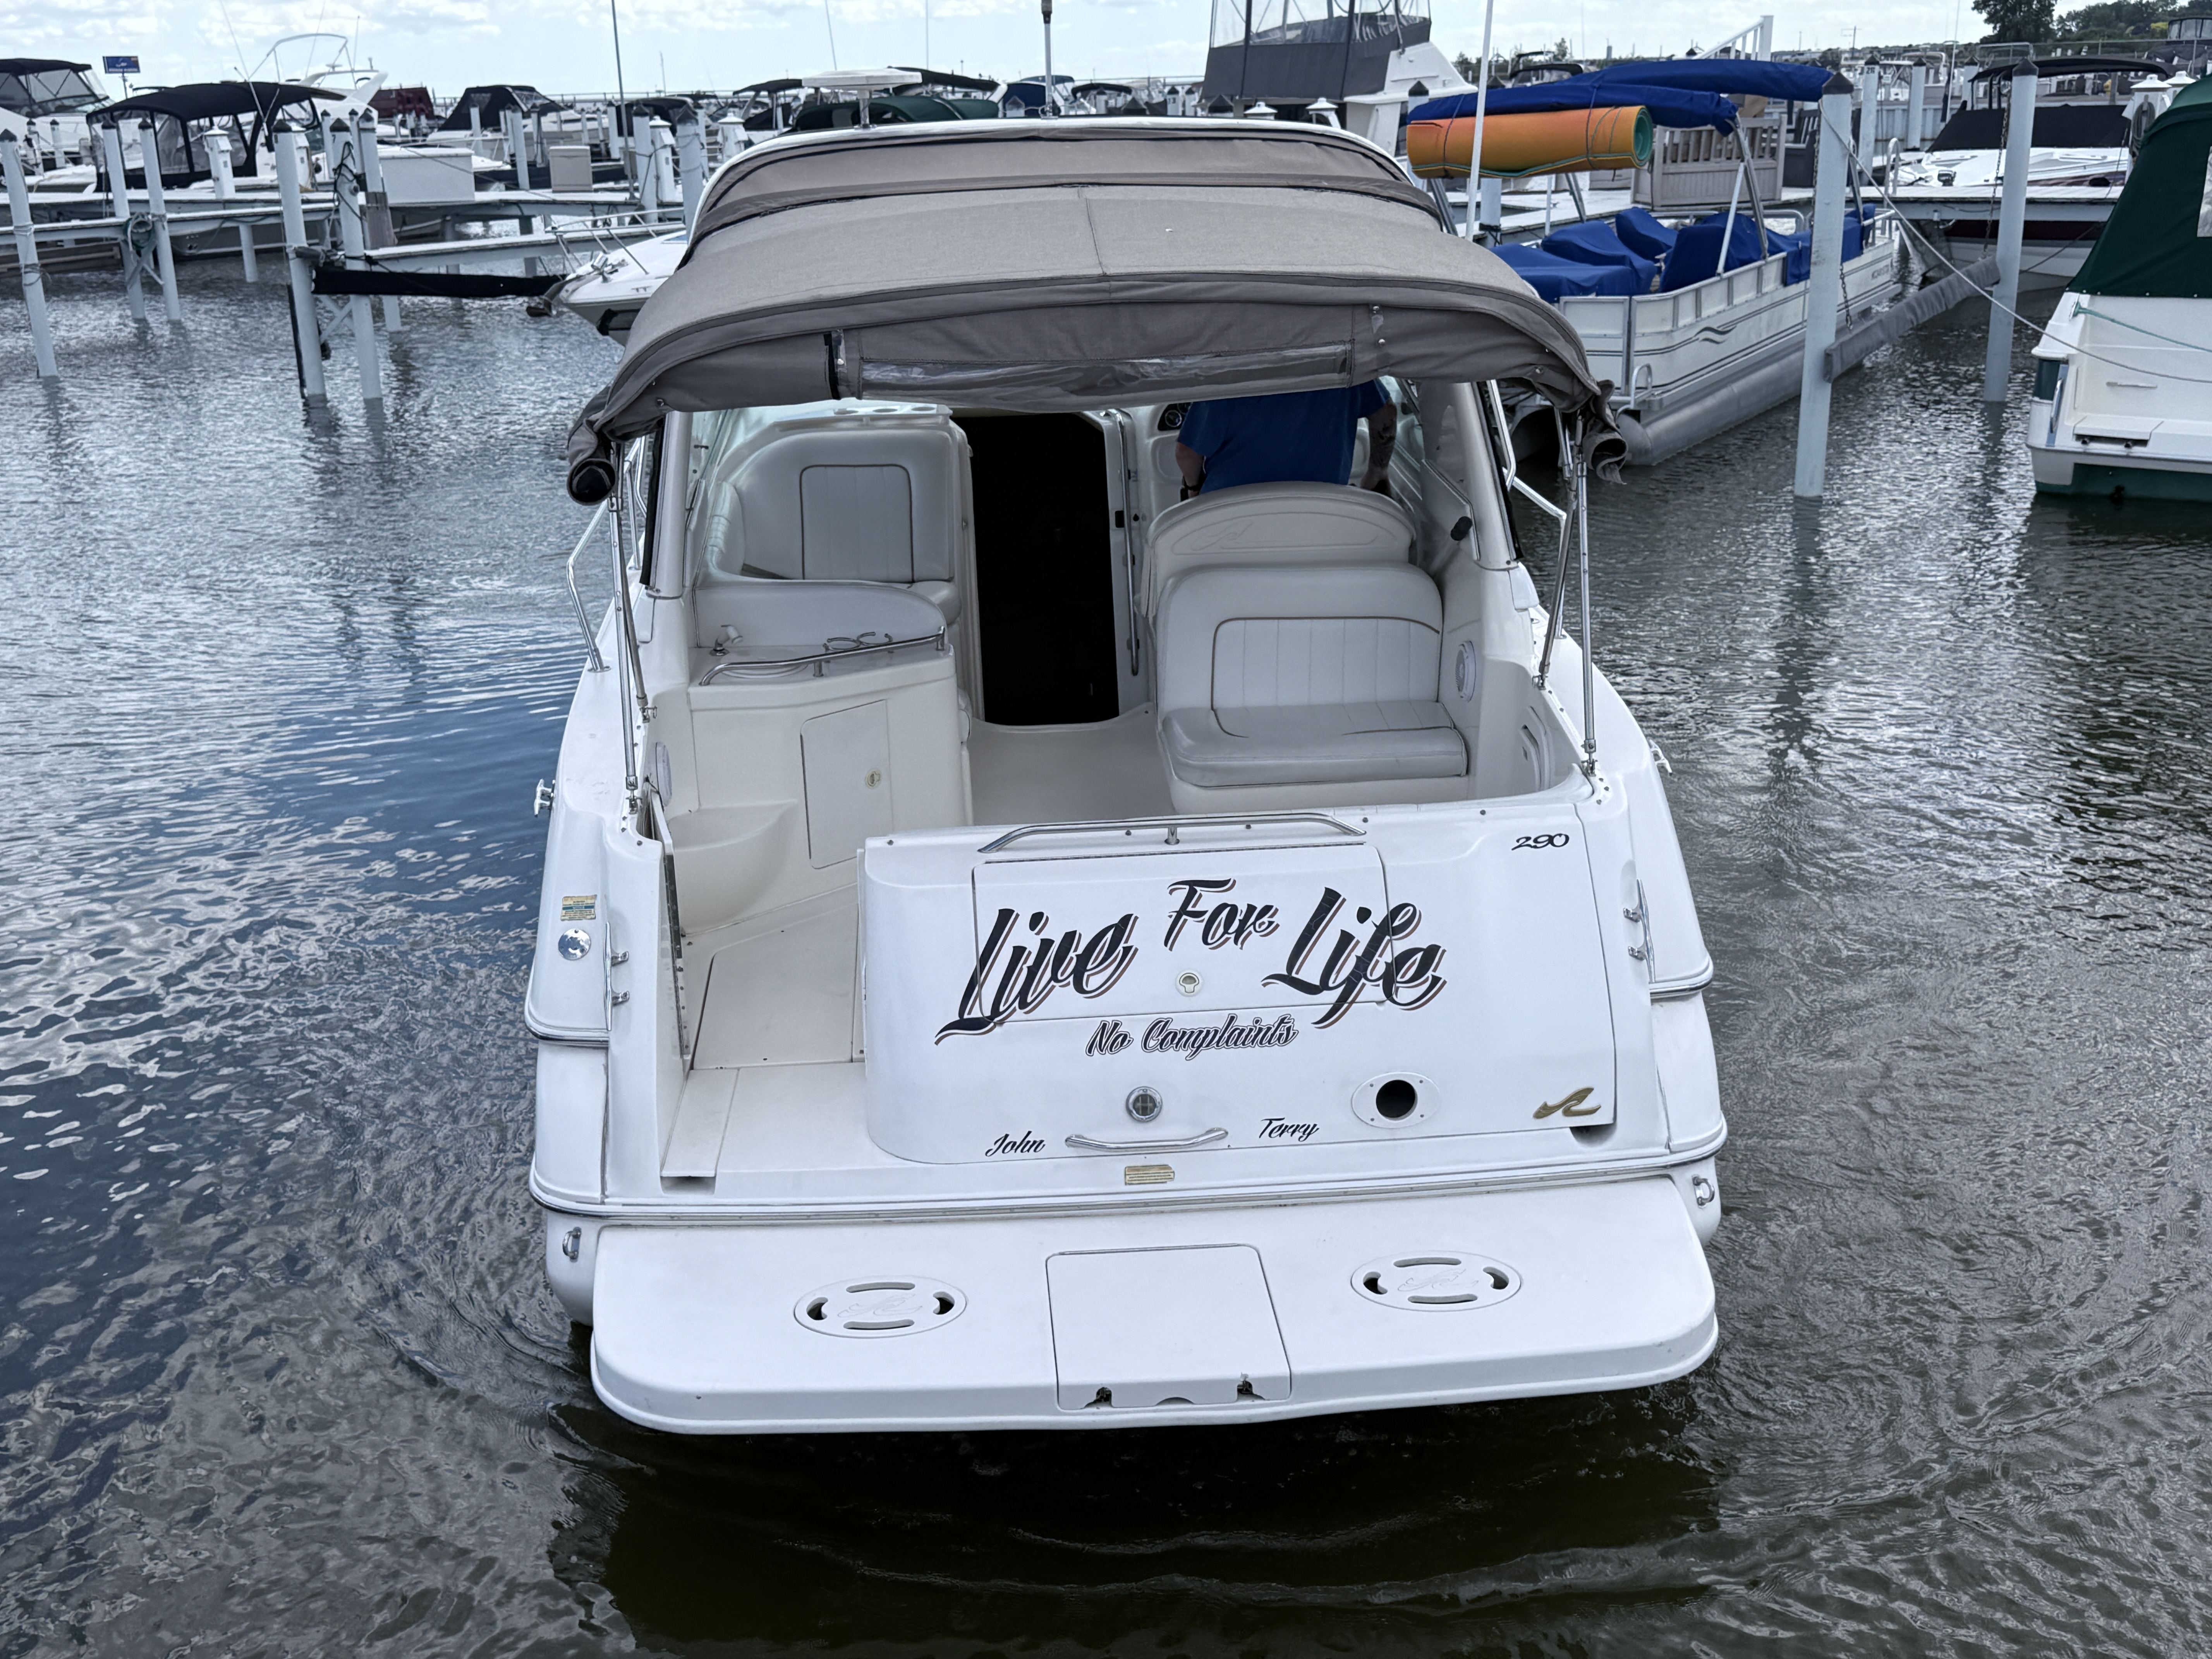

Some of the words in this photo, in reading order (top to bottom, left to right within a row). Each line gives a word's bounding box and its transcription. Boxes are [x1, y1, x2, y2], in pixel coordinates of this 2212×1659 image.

[1511, 833, 1570, 851] 290
[934, 908, 1139, 1046] Live
[1163, 878, 1280, 951] For
[1261, 886, 1447, 1029] Life
[1085, 1020, 1134, 1056] No
[1141, 1013, 1299, 1061] Complaints
[1259, 1117, 1320, 1142] Terry
[985, 1130, 1046, 1157] John
